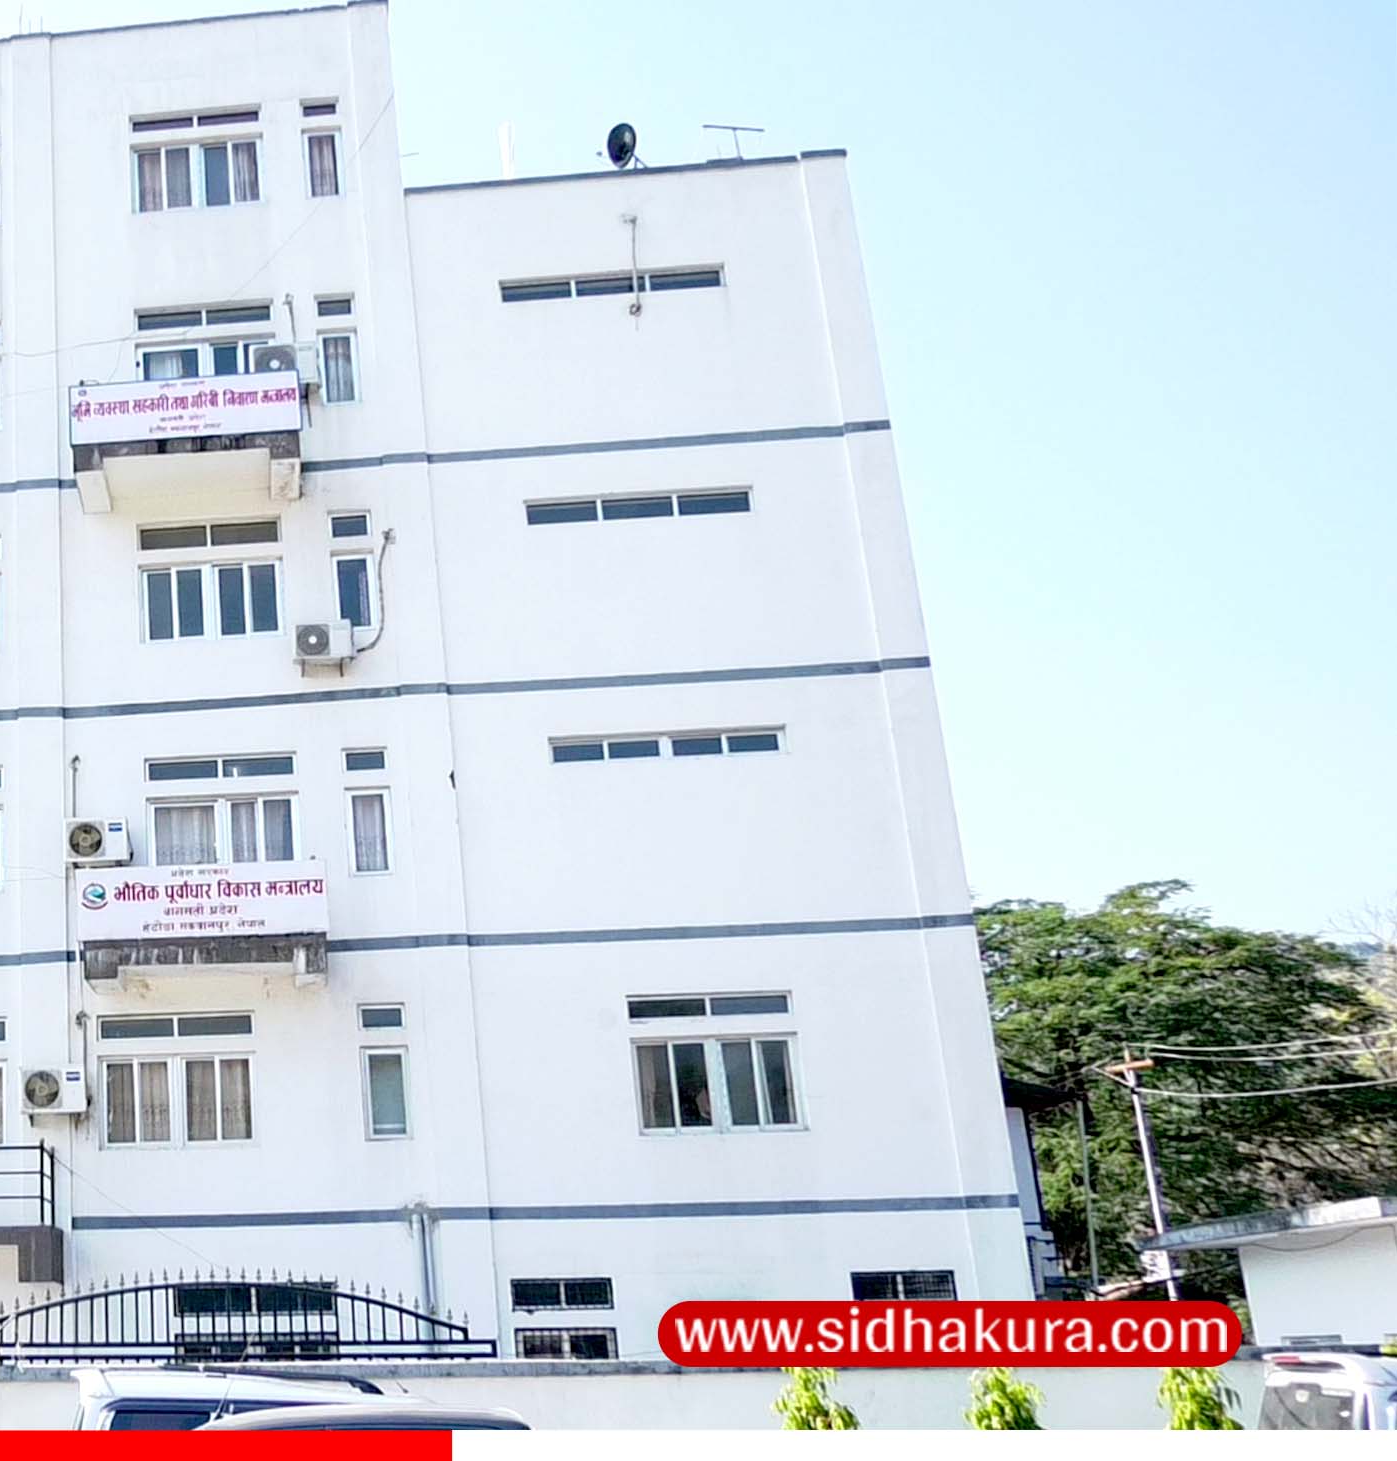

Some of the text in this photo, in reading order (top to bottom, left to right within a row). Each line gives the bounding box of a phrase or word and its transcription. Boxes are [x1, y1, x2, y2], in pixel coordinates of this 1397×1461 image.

[132, 393, 169, 413] सहकारी
[113, 877, 324, 904] भौतिक पूर्वाधार विकास मन्त्रालय
[164, 903, 238, 916] बागमती प्रदेश
